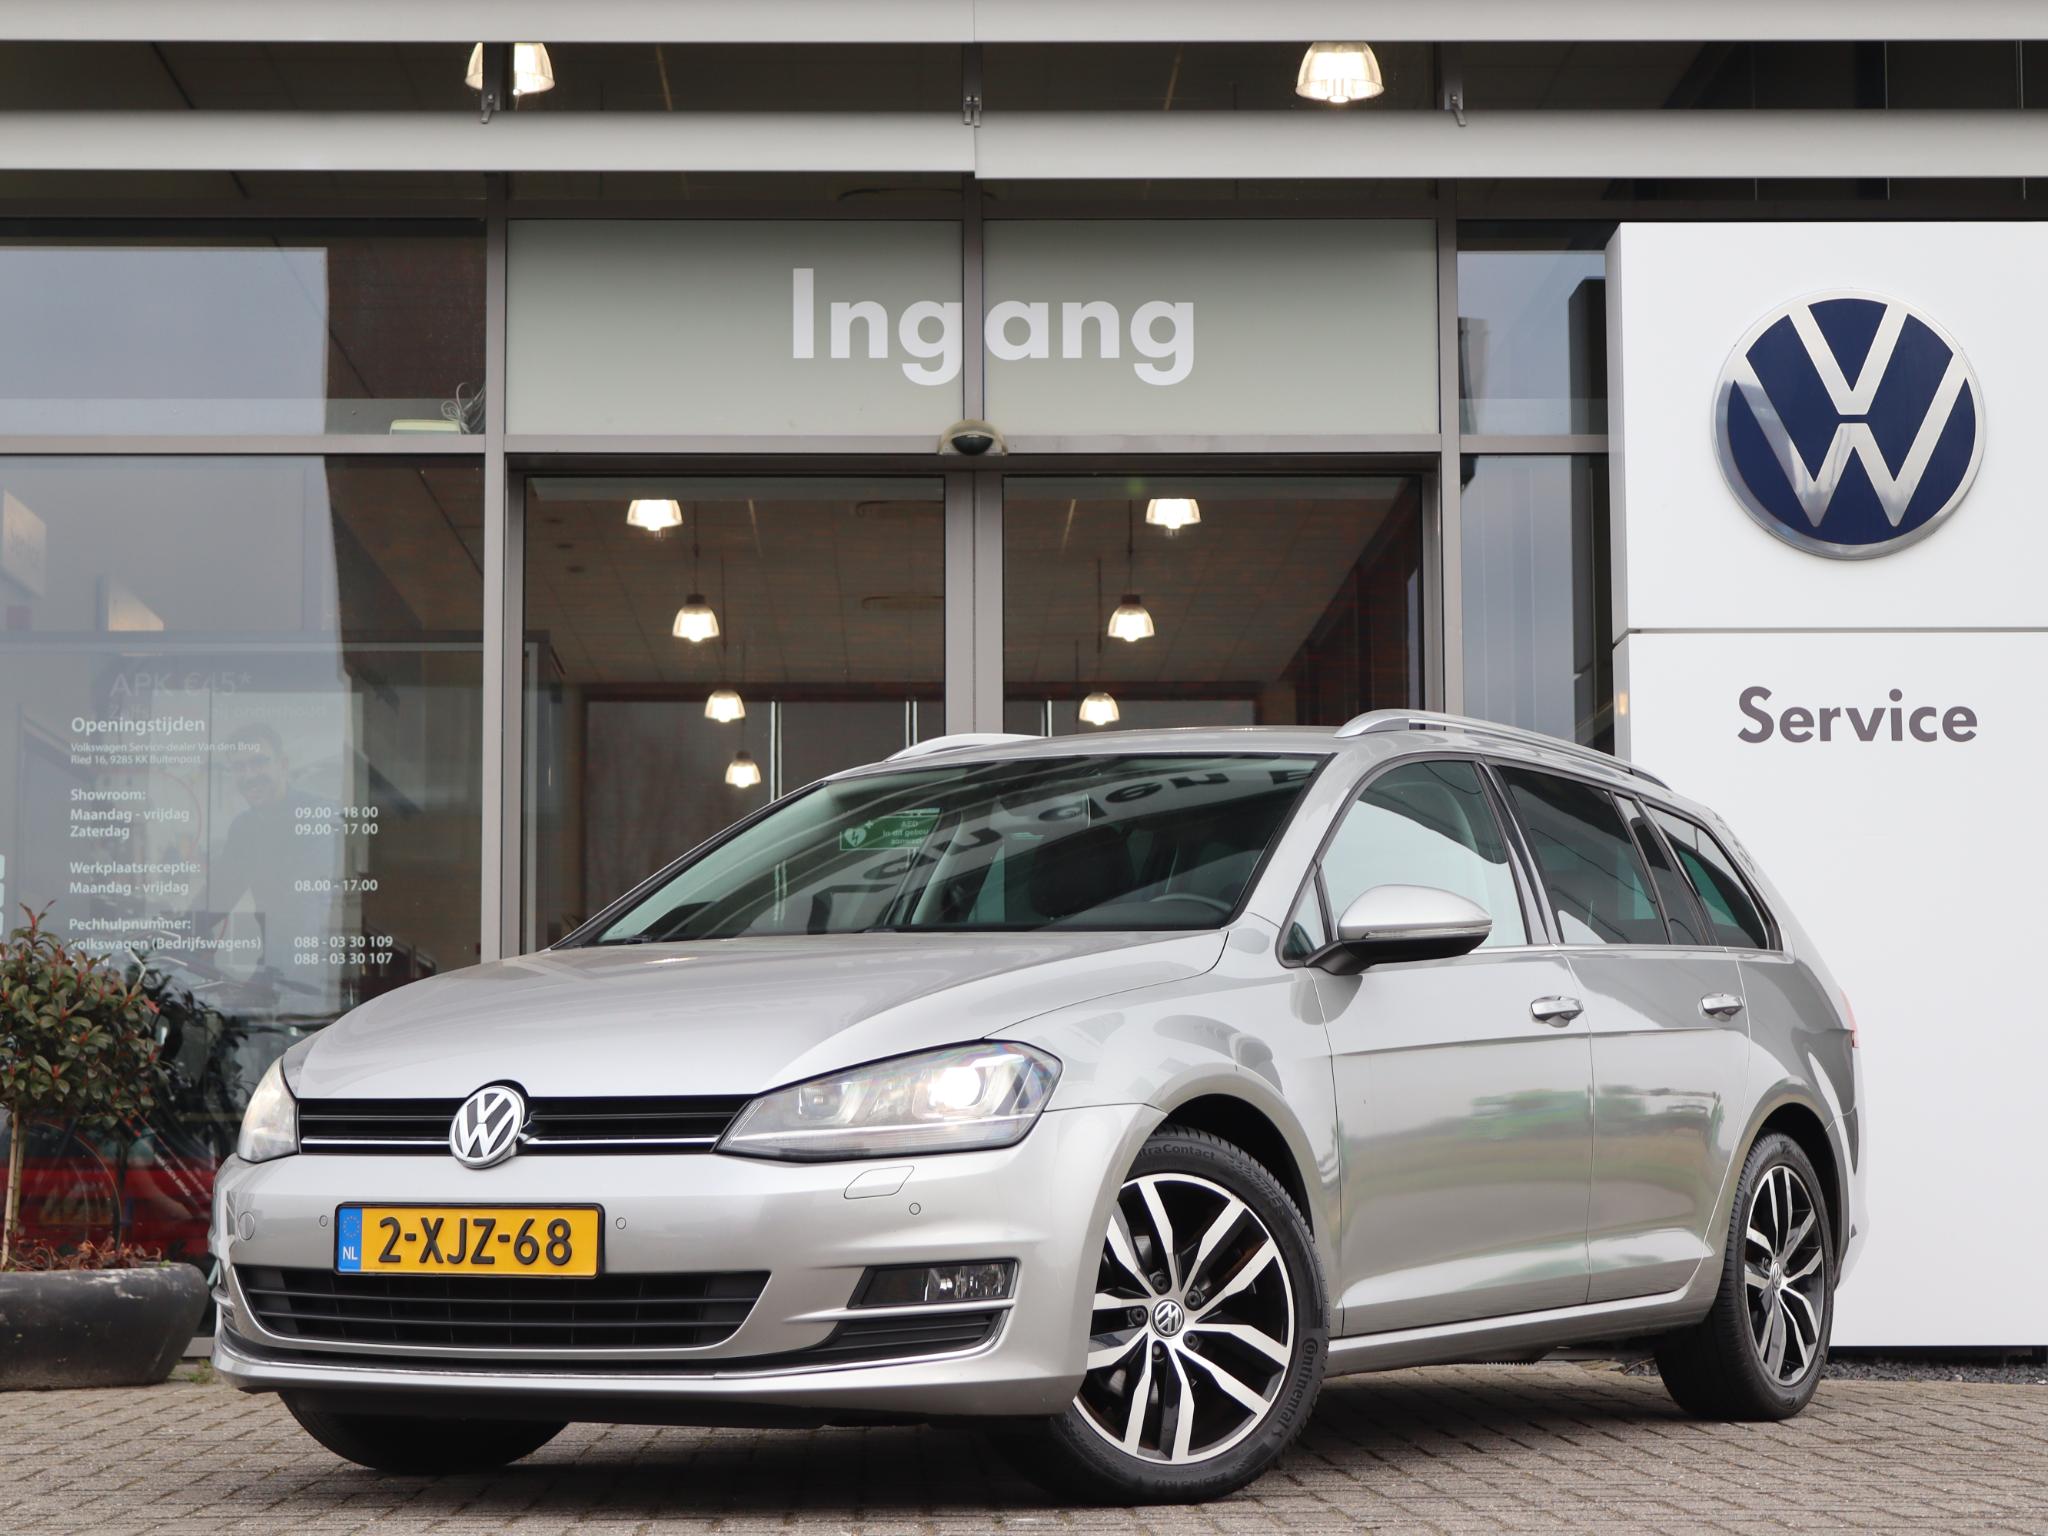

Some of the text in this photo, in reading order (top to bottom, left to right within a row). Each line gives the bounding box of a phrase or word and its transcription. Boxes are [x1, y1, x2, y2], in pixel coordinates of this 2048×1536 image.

[792, 267, 1195, 386] Ingang
[109, 672, 175, 696] APK
[1737, 685, 1978, 744] Service
[71, 717, 205, 736] Openingstijden
[71, 742, 127, 754] Volkswagen
[198, 742, 215, 752] Van
[218, 742, 236, 752] den
[135, 755, 149, 765] KK
[71, 789, 146, 801] Showroom:
[70, 808, 132, 823] Maandag
[143, 808, 190, 822] vrijdag
[295, 807, 332, 818] 09.00
[70, 825, 130, 840] Zaterdag
[295, 823, 332, 835] 09.00
[69, 861, 201, 876] Werkplaatsreceptie:
[69, 881, 132, 896] Maandag
[142, 881, 189, 895] vrijdag
[295, 880, 331, 892] 08.00
[343, 879, 378, 891] 17.00
[69, 918, 192, 931] Pechhulpnummer:
[151, 937, 262, 952] (Bedrijfswagens)
[294, 936, 319, 948] 088
[329, 936, 346, 948] 03
[349, 936, 366, 948] 30
[369, 935, 393, 948] 109
[294, 953, 319, 965] 088
[329, 953, 346, 965] 03
[349, 953, 366, 965] 30
[369, 952, 393, 964] 107
[378, 1216, 573, 1266] 2-XJZ-68
[342, 1246, 359, 1261] NL
